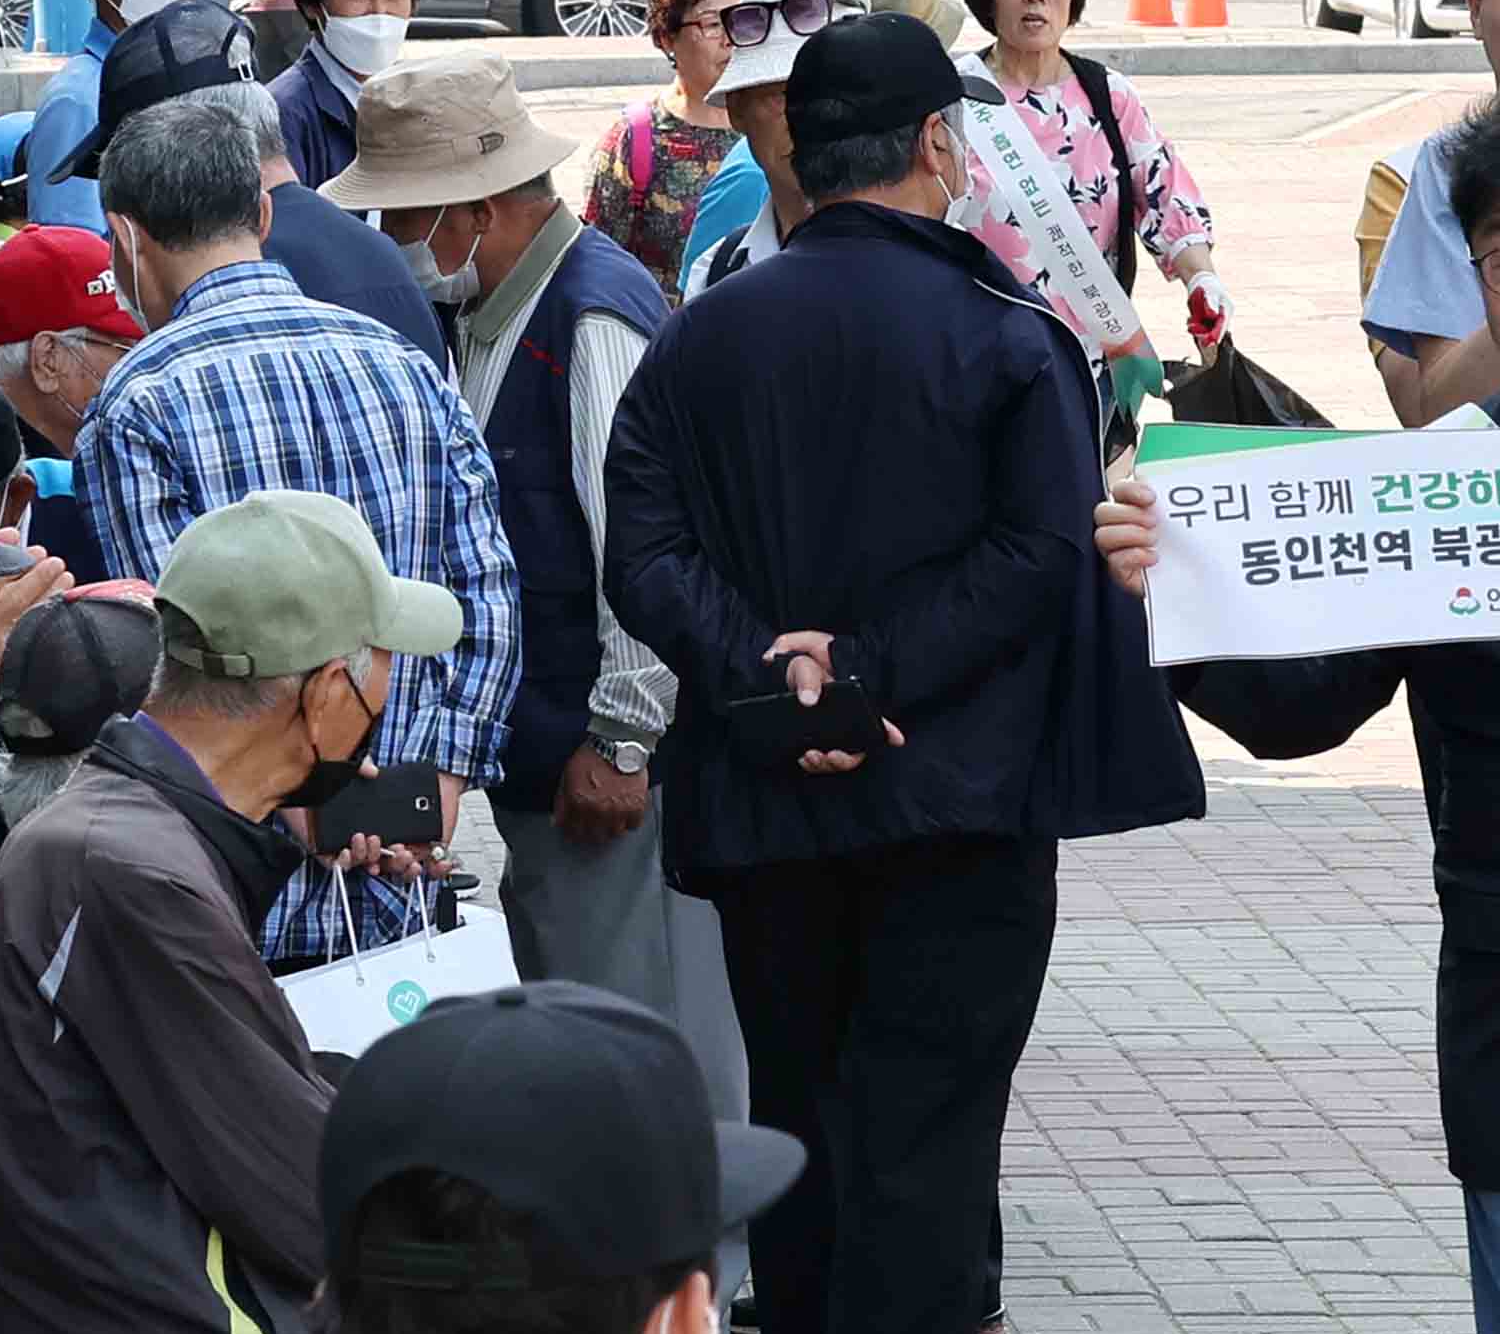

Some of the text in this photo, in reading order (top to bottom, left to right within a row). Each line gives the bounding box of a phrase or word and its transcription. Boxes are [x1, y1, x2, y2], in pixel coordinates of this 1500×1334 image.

[1167, 479, 1252, 526] 우리
[1266, 477, 1354, 519] 함께
[1240, 527, 1414, 589] 동인천역
